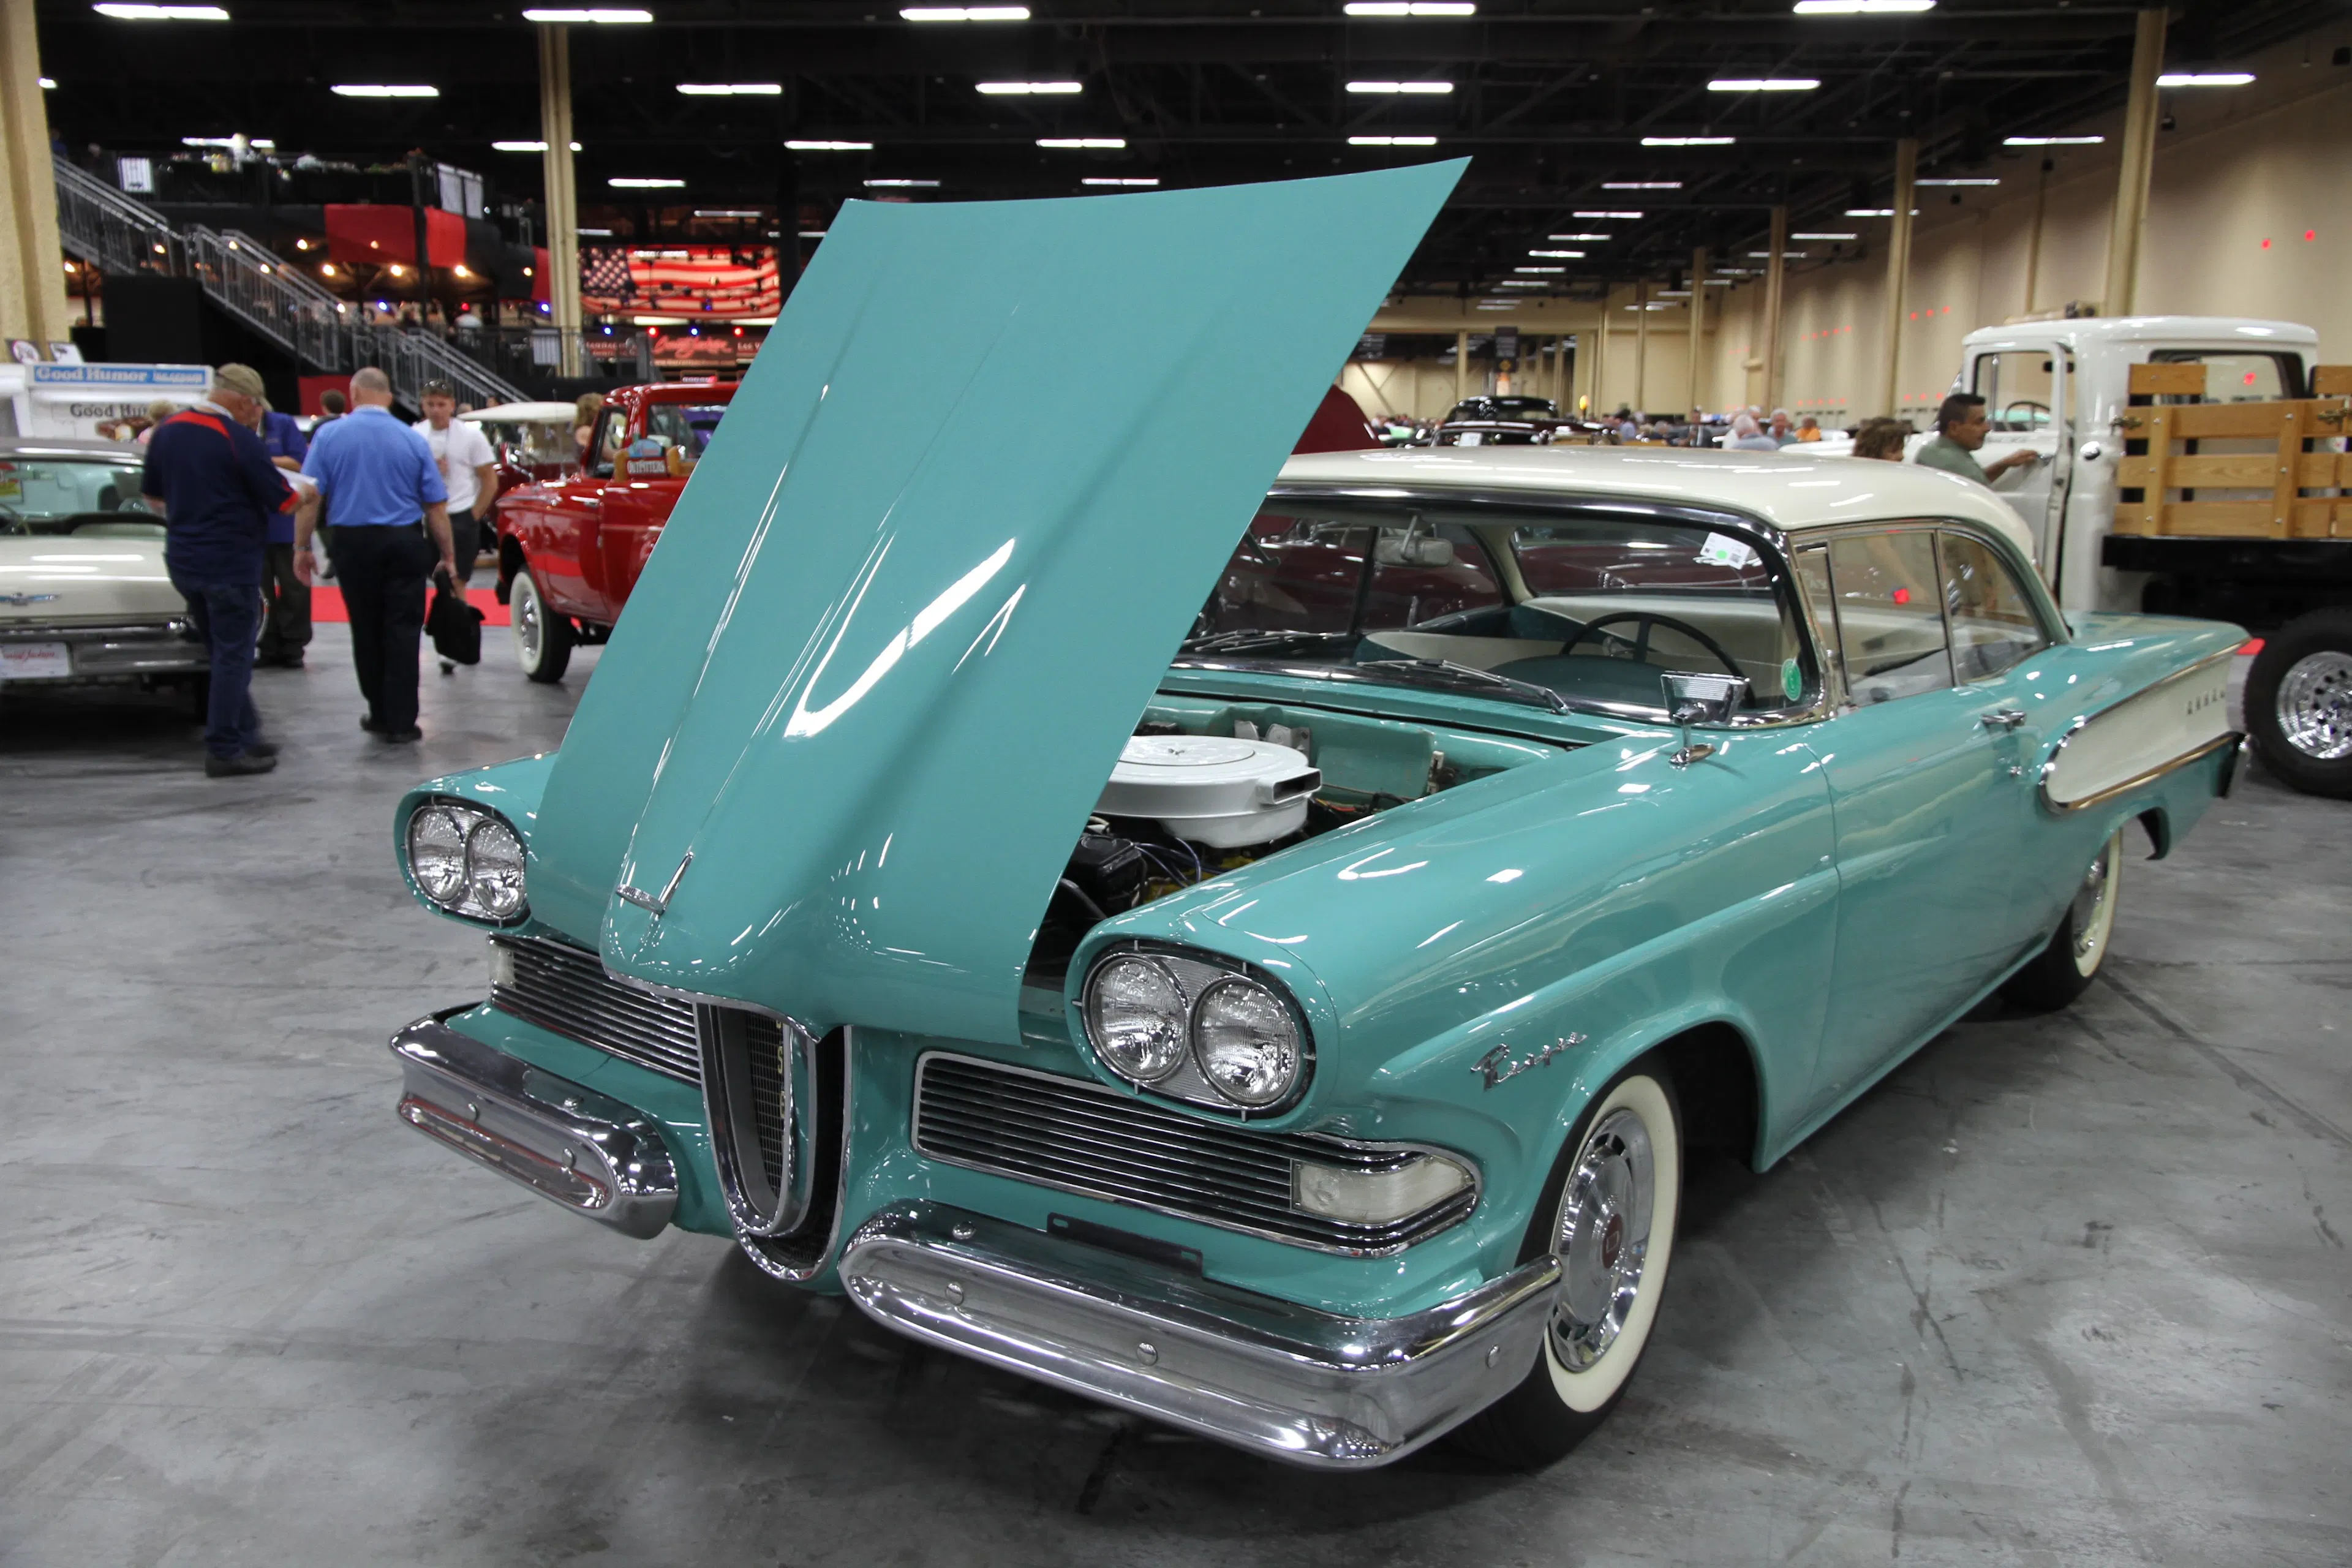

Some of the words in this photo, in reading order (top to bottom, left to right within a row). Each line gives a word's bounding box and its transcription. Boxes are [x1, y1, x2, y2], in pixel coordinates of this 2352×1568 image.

[36, 366, 83, 380] Good
[86, 367, 147, 382] Humor
[70, 402, 113, 417] Good
